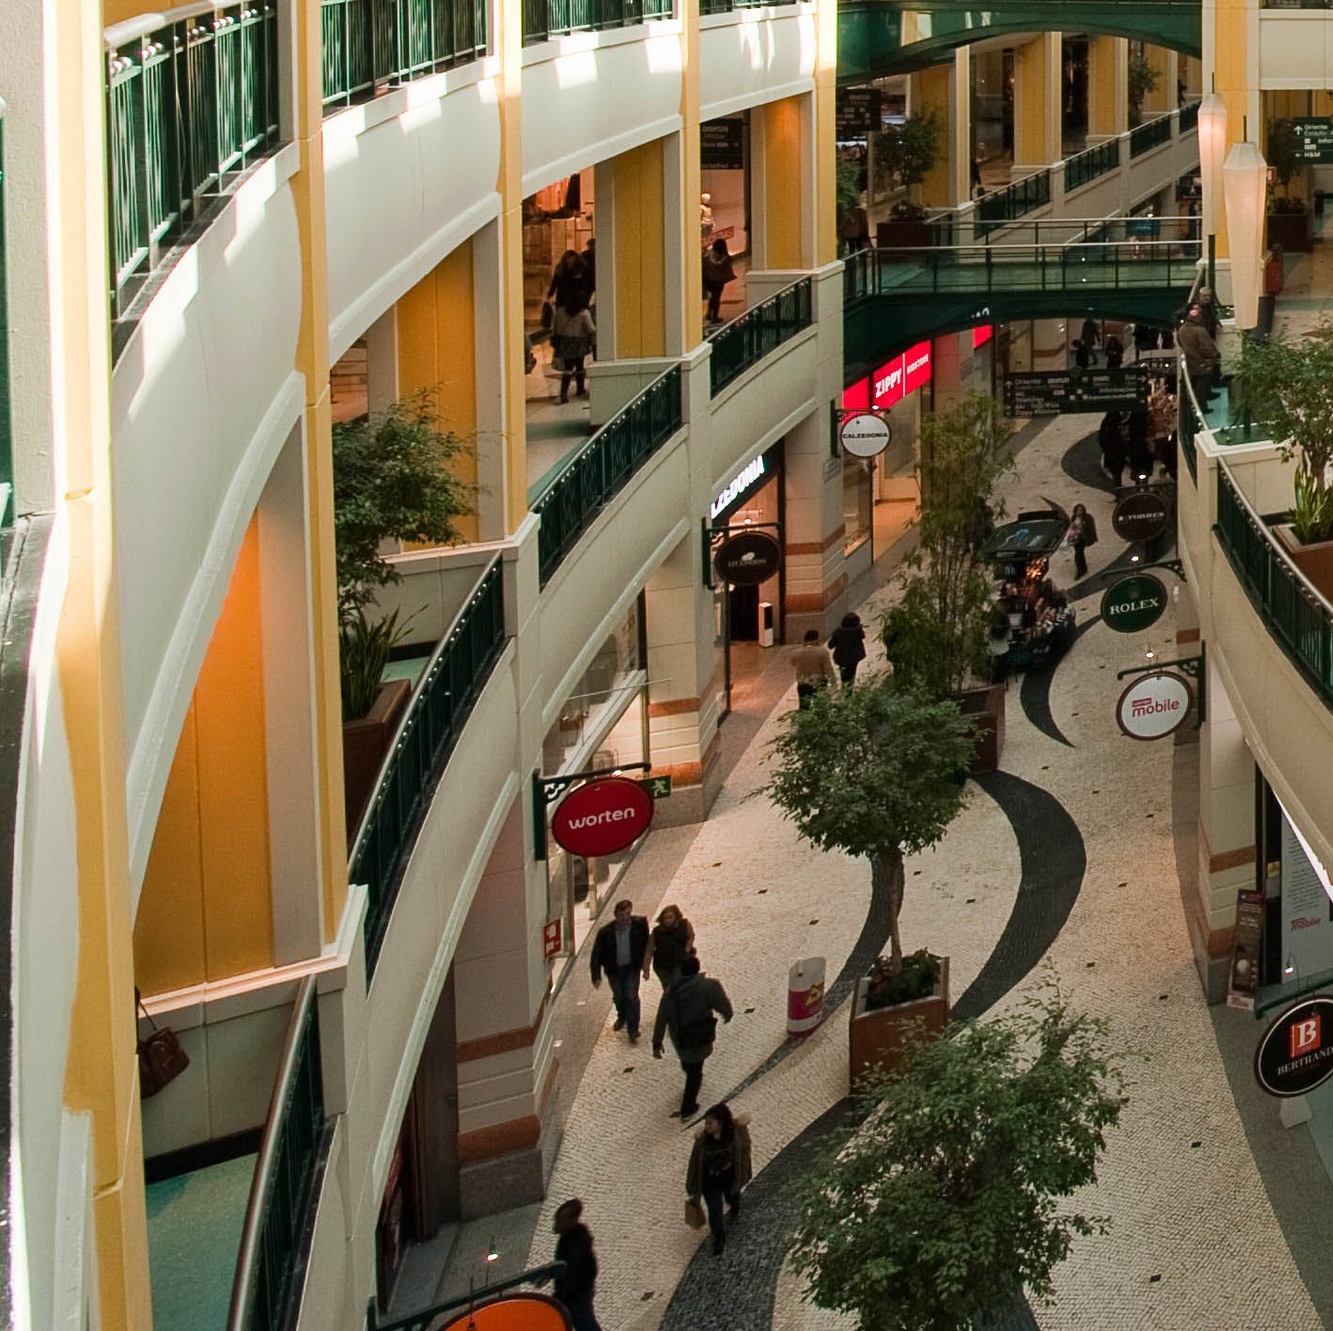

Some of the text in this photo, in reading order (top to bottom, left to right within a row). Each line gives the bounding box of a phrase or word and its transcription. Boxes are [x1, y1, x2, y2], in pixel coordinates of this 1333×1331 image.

[875, 368, 902, 399] ZIPPY
[1109, 597, 1160, 616] ROLEX
[1132, 698, 1180, 718] mobile
[568, 807, 636, 830] worten
